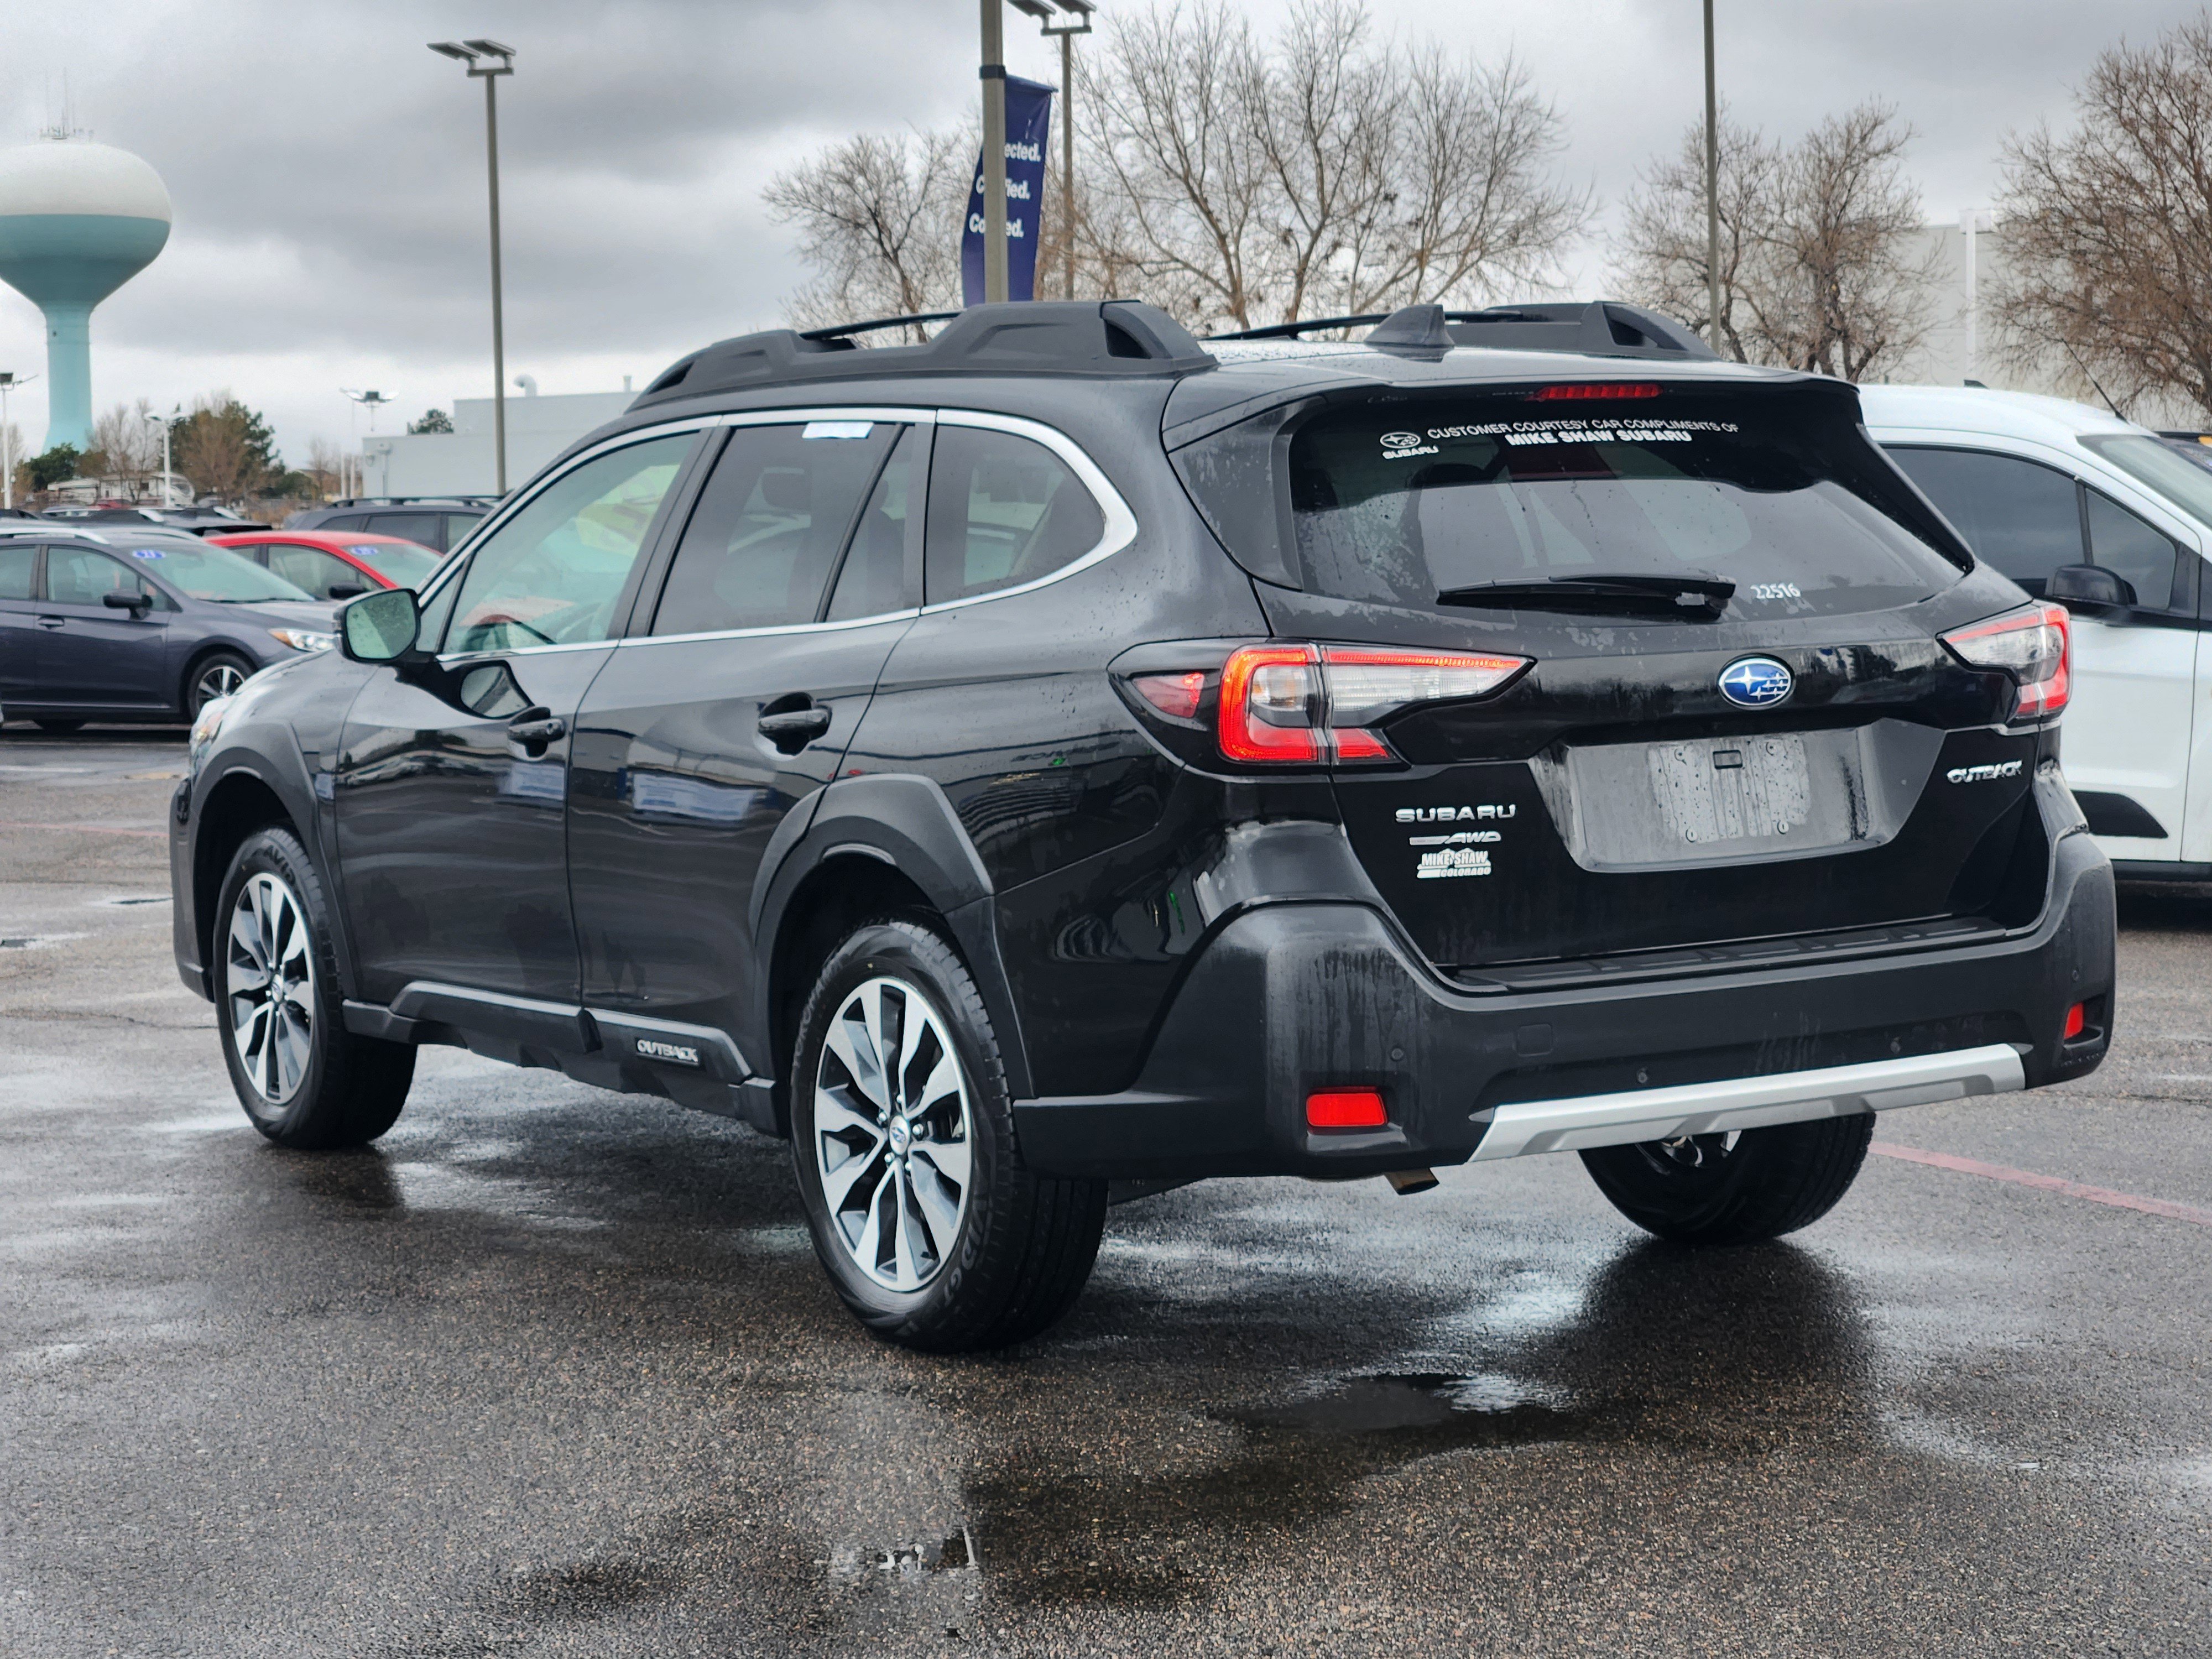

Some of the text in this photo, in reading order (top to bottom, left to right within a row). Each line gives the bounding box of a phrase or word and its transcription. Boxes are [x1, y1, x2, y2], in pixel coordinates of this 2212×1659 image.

[1004, 142, 1041, 161] ected.
[1427, 420, 1740, 439] CUSTOMER COURTESY CAR COMPLIMENTS OF
[1505, 430, 1692, 446] MIKE SHAW SUBARU
[1383, 445, 1439, 459] SUBARU
[1750, 582, 1801, 599] 22516
[1947, 760, 2022, 783] OUTBACK
[1395, 804, 1516, 823] SUBARU
[1444, 831, 1501, 844] AWD
[1421, 851, 1488, 866] MIKE SHAW
[1440, 867, 1491, 877] COLORADO
[637, 1039, 699, 1062] OUTBACK
